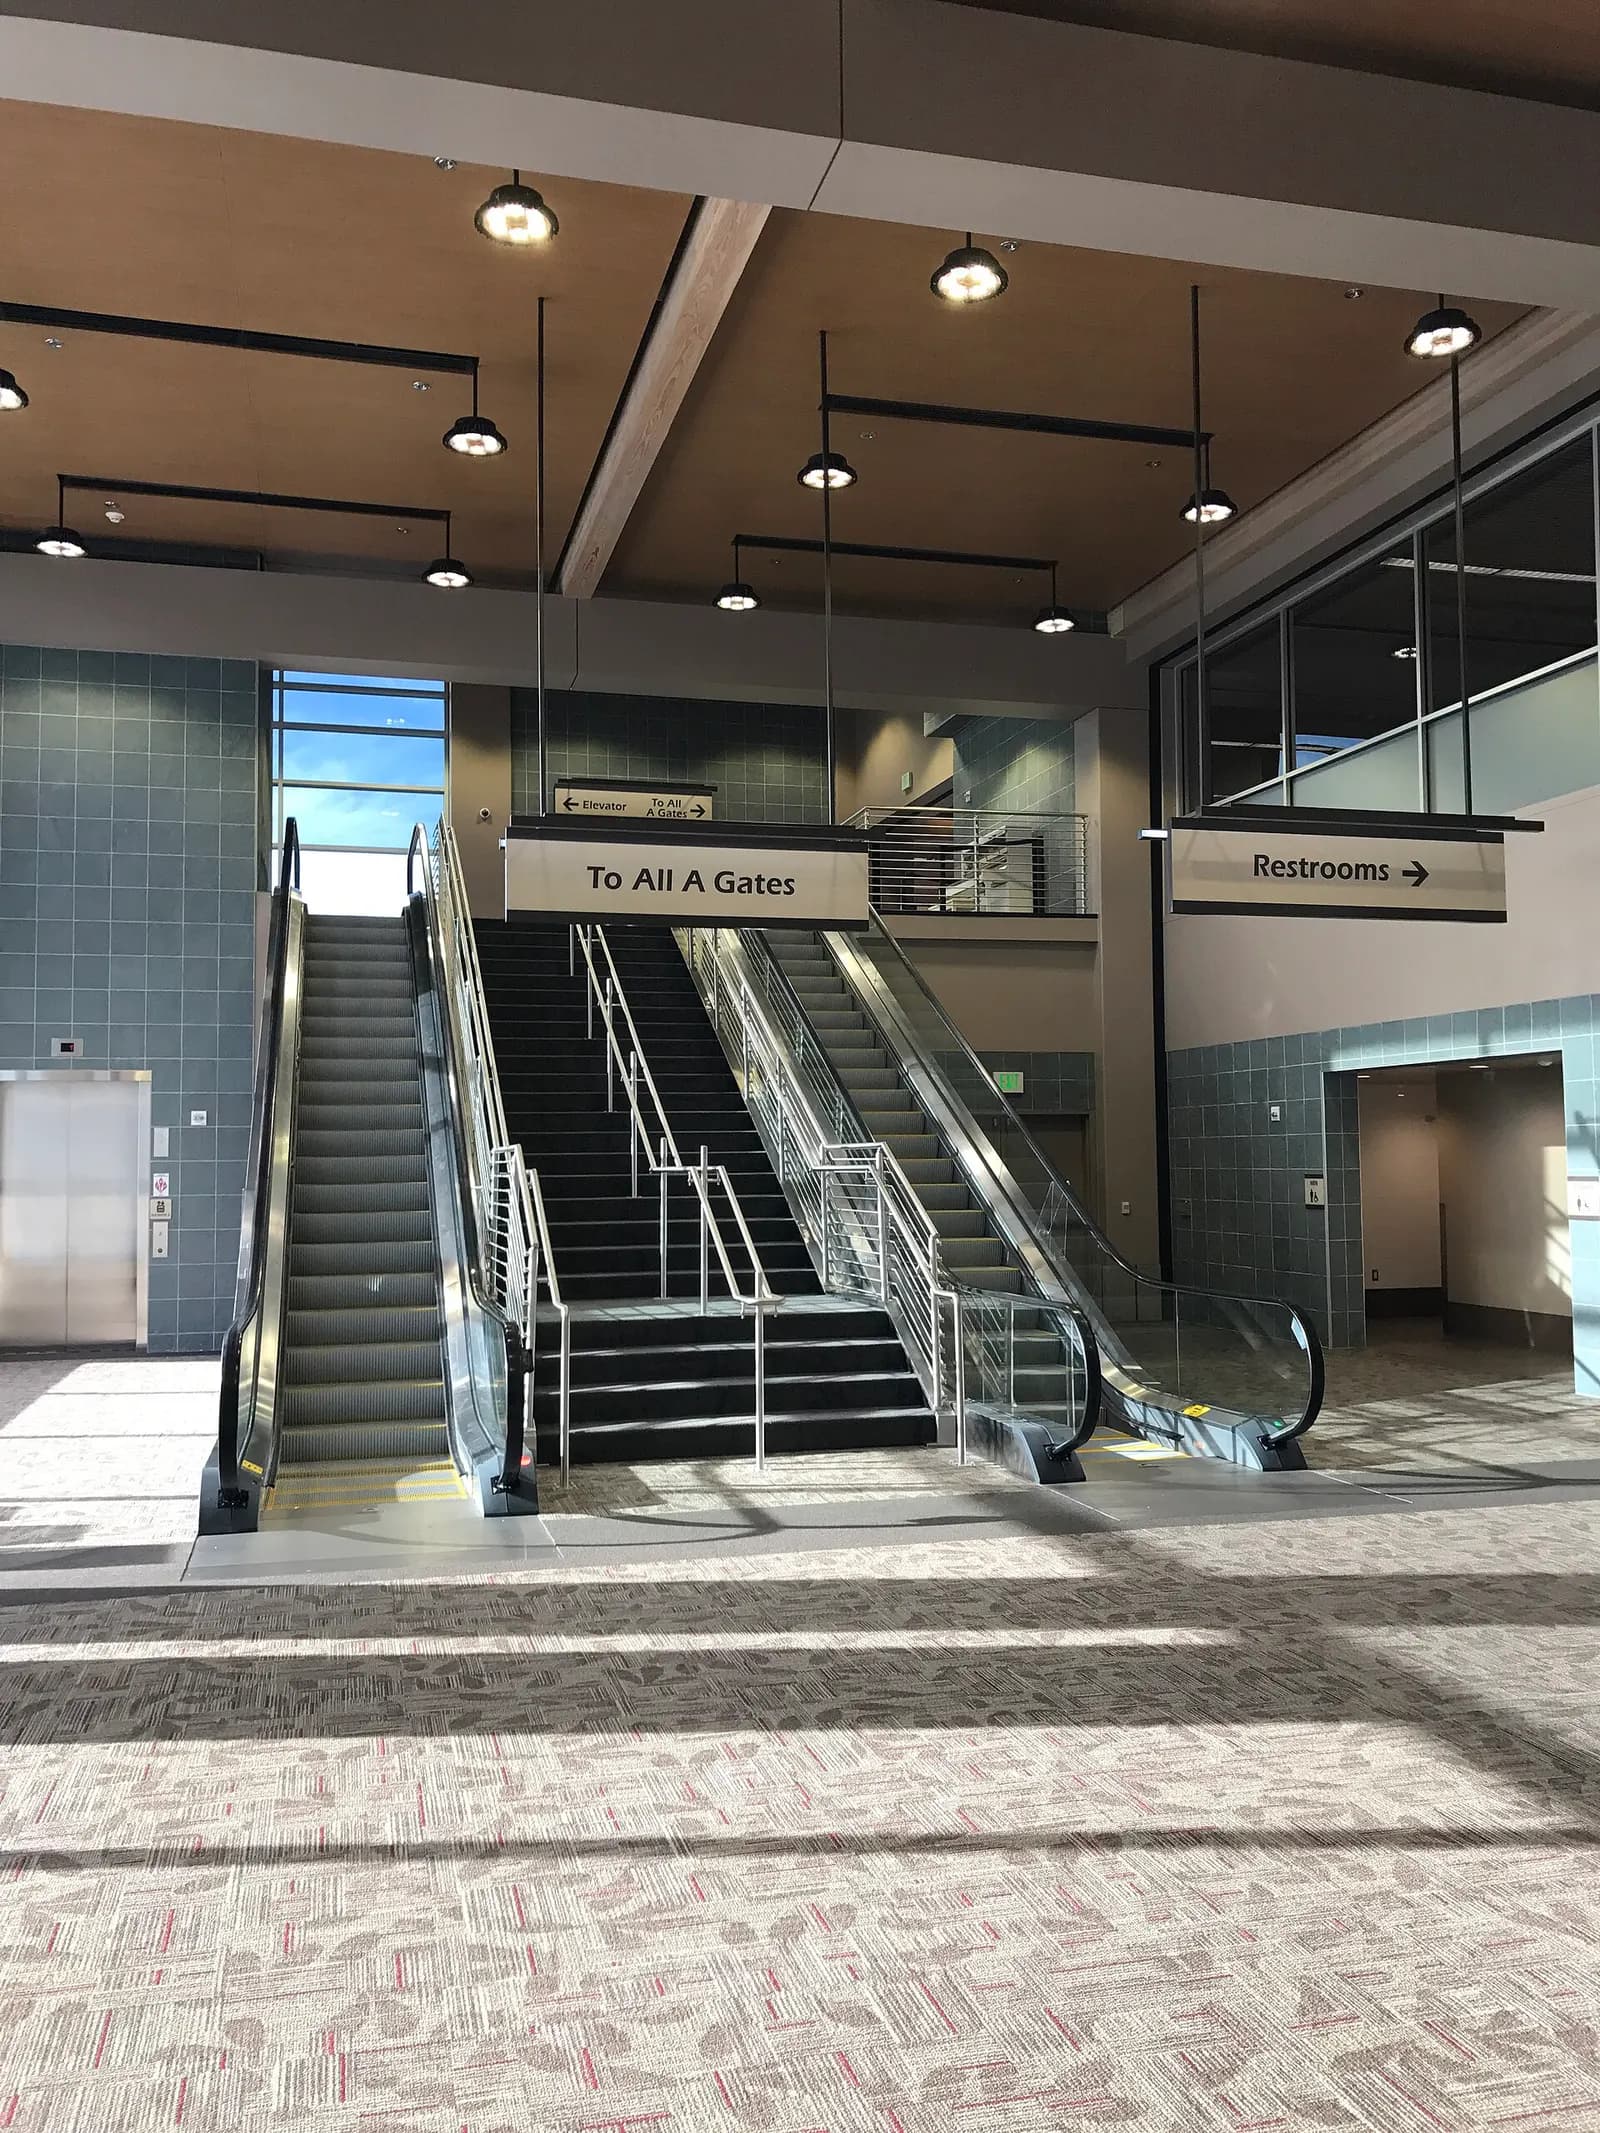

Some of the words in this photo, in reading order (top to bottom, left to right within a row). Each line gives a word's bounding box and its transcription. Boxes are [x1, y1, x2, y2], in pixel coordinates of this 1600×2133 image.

[583, 800, 627, 812] Elevator
[652, 798, 664, 808] To
[667, 799, 681, 808] All
[646, 808, 654, 817] A
[658, 808, 687, 818] Gates
[1254, 854, 1389, 881] Restrooms
[587, 866, 622, 890] To
[632, 868, 673, 892] All
[682, 870, 705, 893] A
[714, 871, 796, 896] Gates
